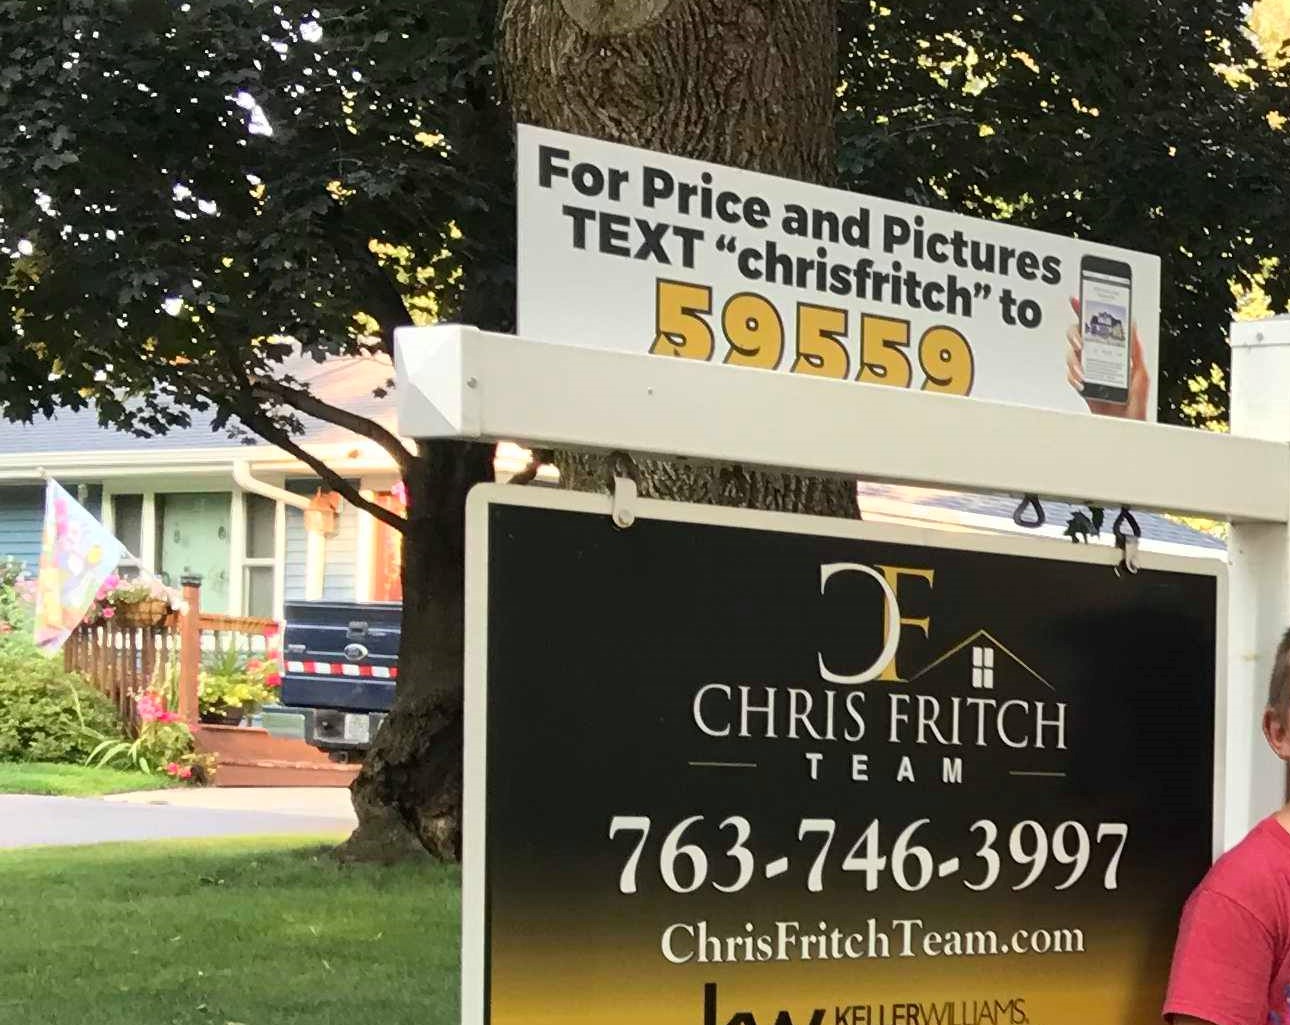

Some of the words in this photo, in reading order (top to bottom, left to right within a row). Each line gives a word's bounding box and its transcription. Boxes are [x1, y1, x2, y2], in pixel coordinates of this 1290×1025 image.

[538, 145, 629, 199] For
[643, 165, 771, 228] Price
[782, 202, 870, 249] and
[883, 215, 1062, 286] Pictures
[562, 205, 704, 268] TEXT
[1000, 287, 1042, 329] to
[648, 277, 975, 397] 59559
[693, 683, 866, 743] CHRIS
[888, 694, 1068, 749] FRITCH
[806, 753, 963, 783] TEAM
[609, 815, 1128, 894] 763-746-3997
[660, 919, 1086, 964] ChrisFritchTeam.com
